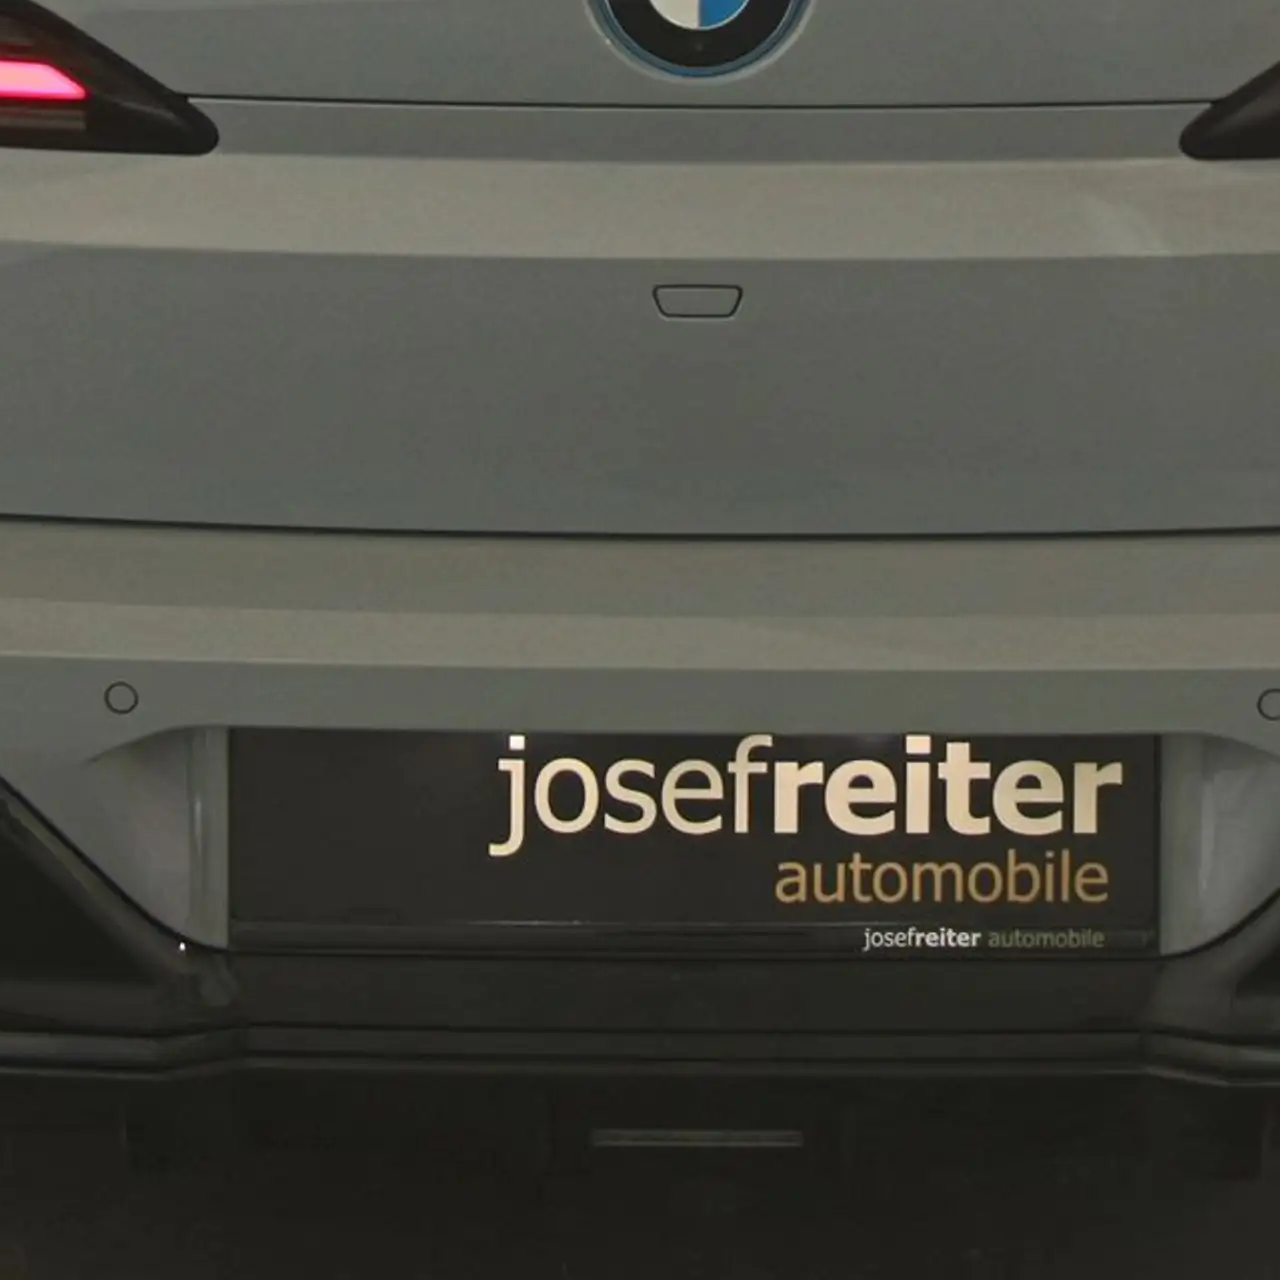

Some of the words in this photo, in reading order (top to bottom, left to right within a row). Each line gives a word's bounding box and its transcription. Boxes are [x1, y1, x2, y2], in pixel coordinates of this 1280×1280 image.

[488, 734, 1124, 857] josefreiter
[774, 848, 1110, 903] automobile
[862, 927, 982, 951] josefreiter
[987, 928, 1106, 949] automobile
